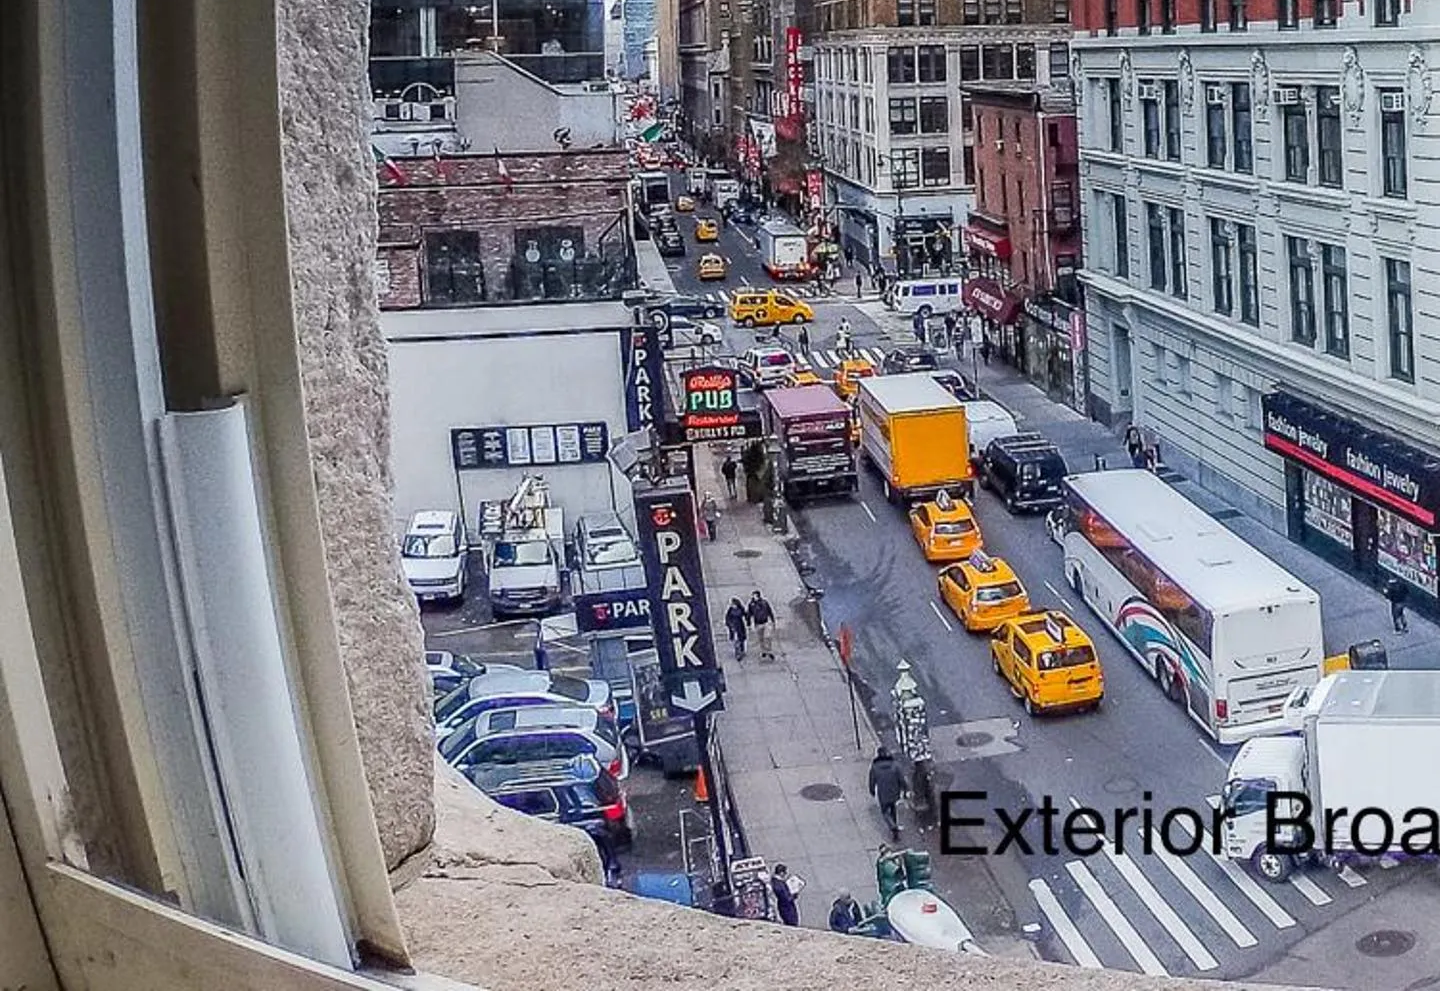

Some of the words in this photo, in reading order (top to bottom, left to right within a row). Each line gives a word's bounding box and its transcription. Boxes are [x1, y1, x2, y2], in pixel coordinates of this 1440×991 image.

[634, 348, 654, 422] PARK
[690, 389, 734, 410] PUB
[1267, 411, 1297, 441] fashion
[1346, 447, 1381, 481] fashion
[1383, 463, 1420, 502] jewelry
[613, 599, 650, 619] PAR
[655, 530, 703, 669] PARK
